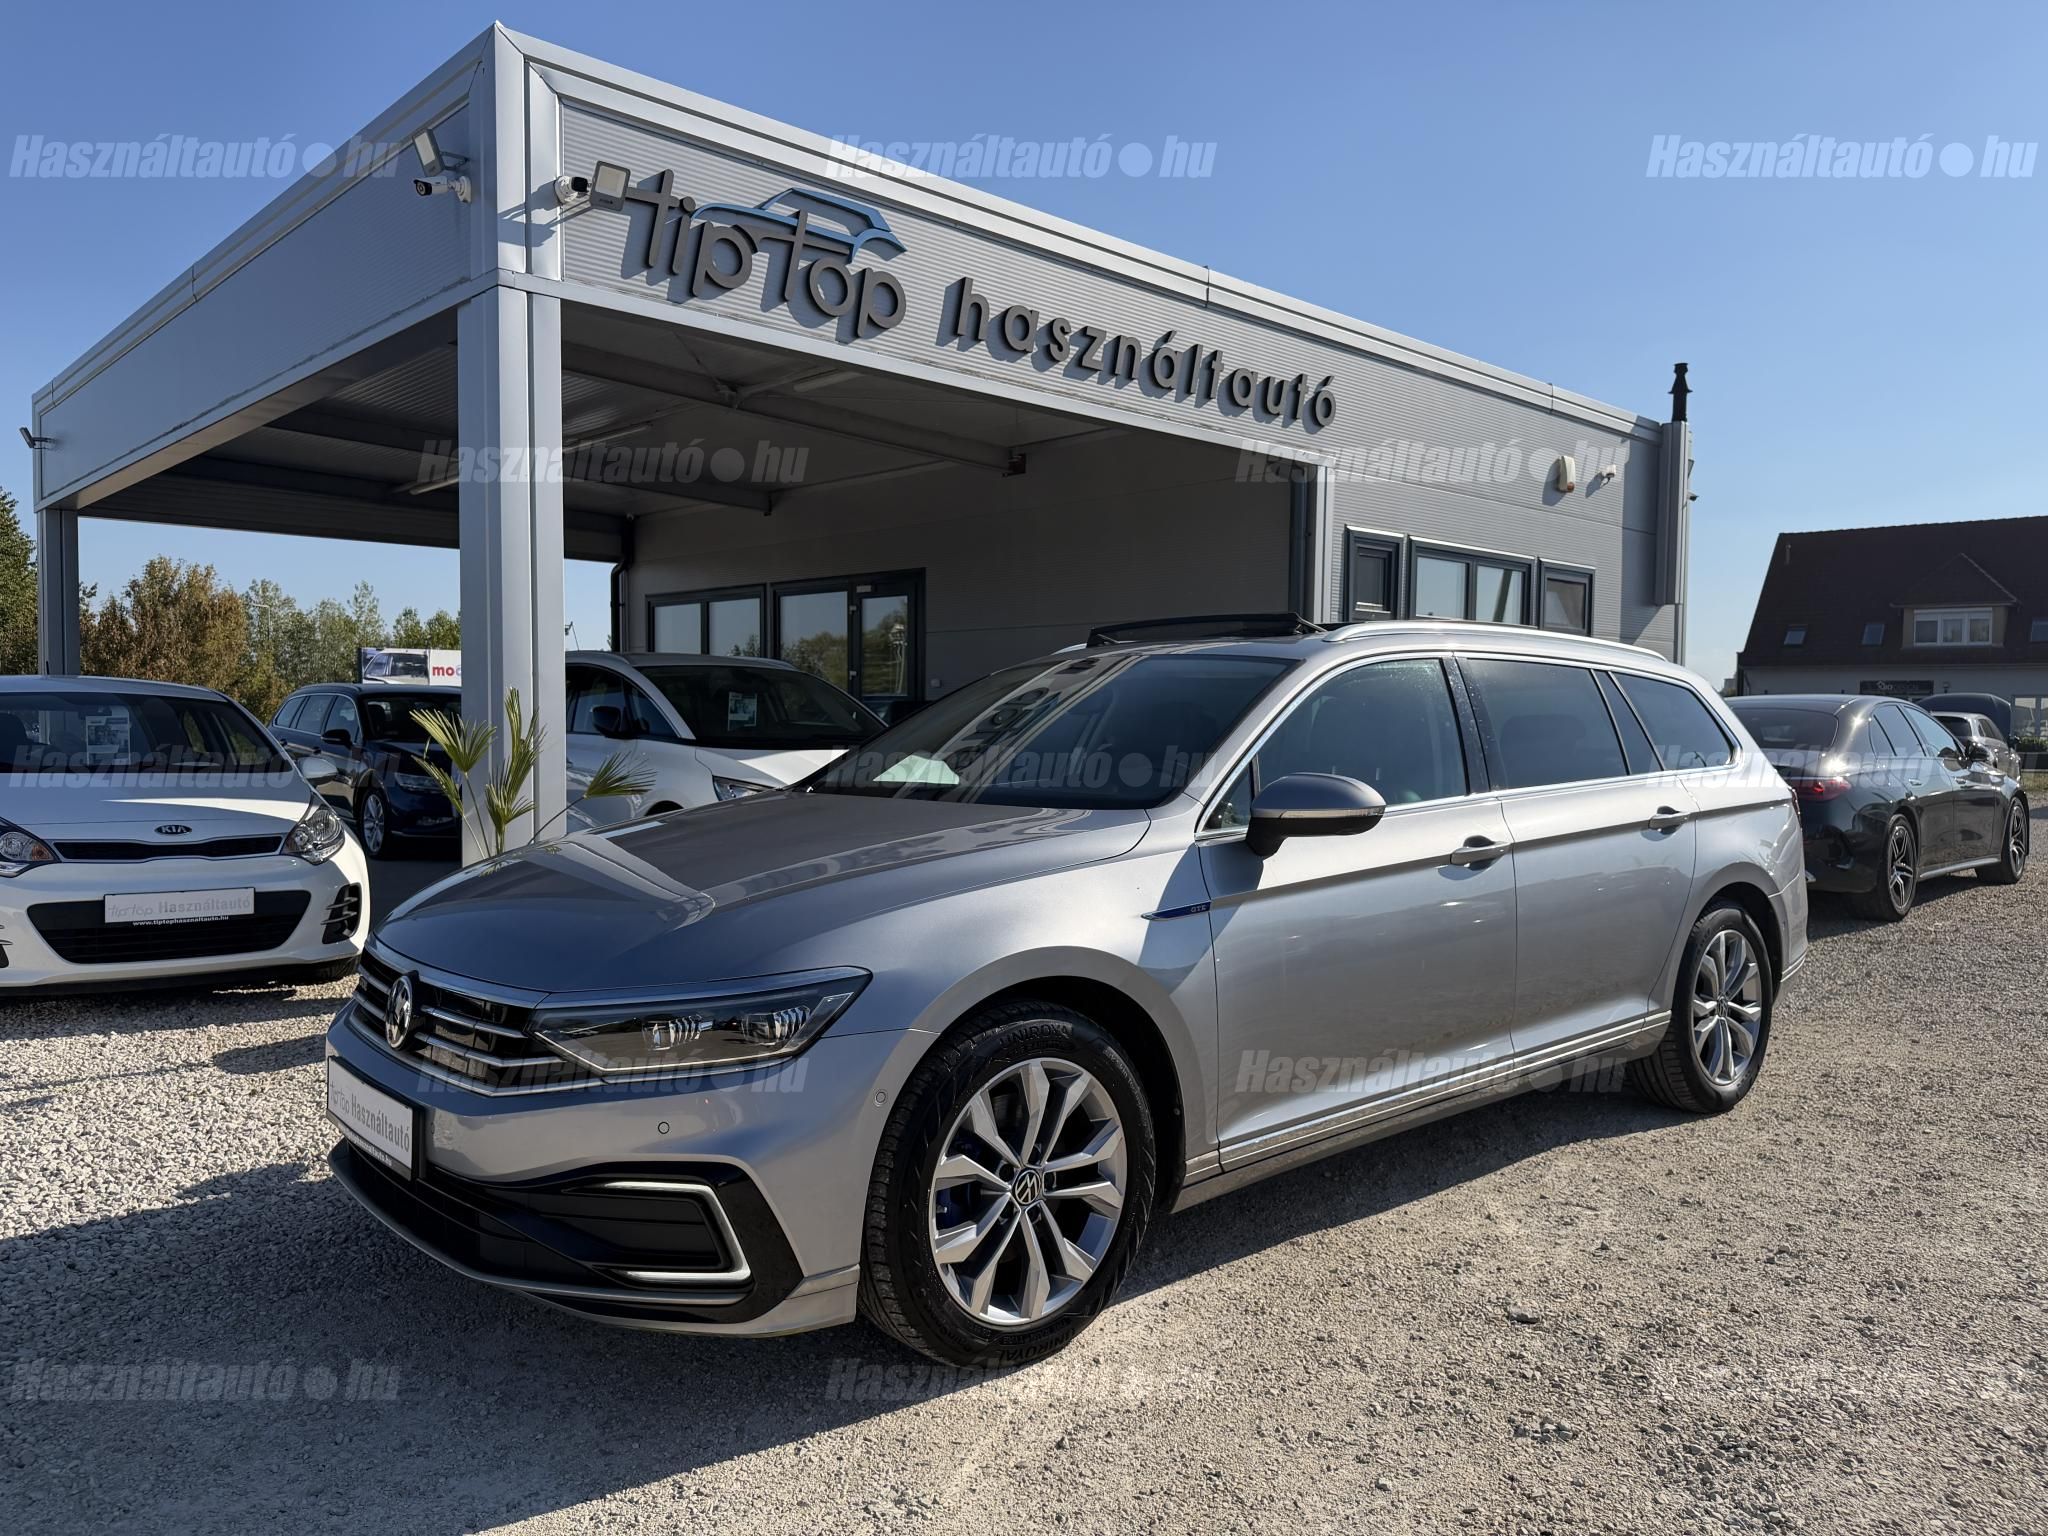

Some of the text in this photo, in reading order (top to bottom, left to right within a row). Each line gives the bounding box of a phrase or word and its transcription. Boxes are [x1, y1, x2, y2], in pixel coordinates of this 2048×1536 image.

[956, 276, 1337, 427] használtautó
[161, 825, 187, 833] KIA
[158, 895, 251, 914] Használtautó
[1000, 1023, 1074, 1048] UNIROYA
[351, 1092, 410, 1153] Használtautó
